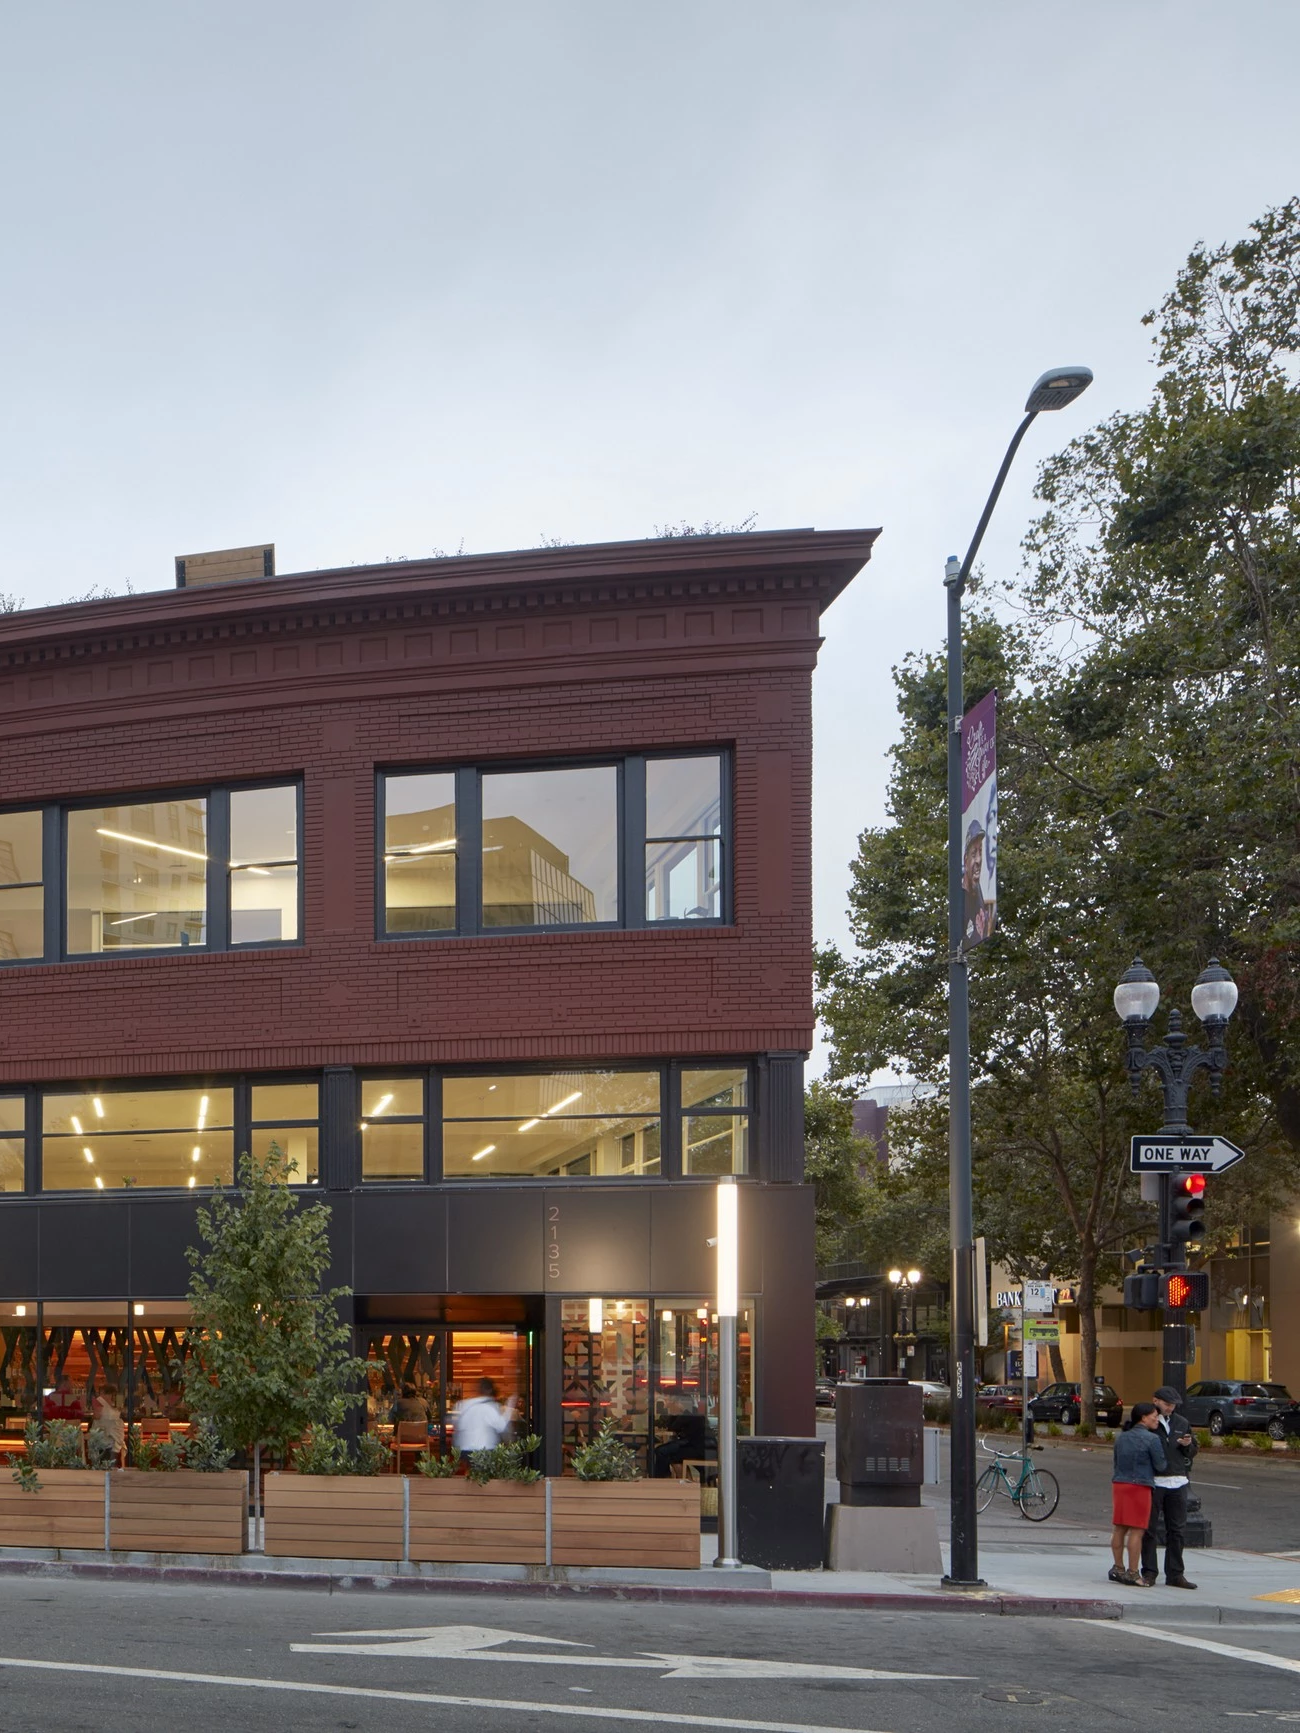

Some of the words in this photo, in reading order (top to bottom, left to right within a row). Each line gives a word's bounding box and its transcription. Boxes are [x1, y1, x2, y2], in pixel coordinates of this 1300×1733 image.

[1144, 1147, 1174, 1161] ONE
[1180, 1147, 1211, 1161] WAY
[548, 1206, 560, 1279] 2135
[997, 1291, 1022, 1307] BANK
[1030, 1288, 1040, 1296] 12
